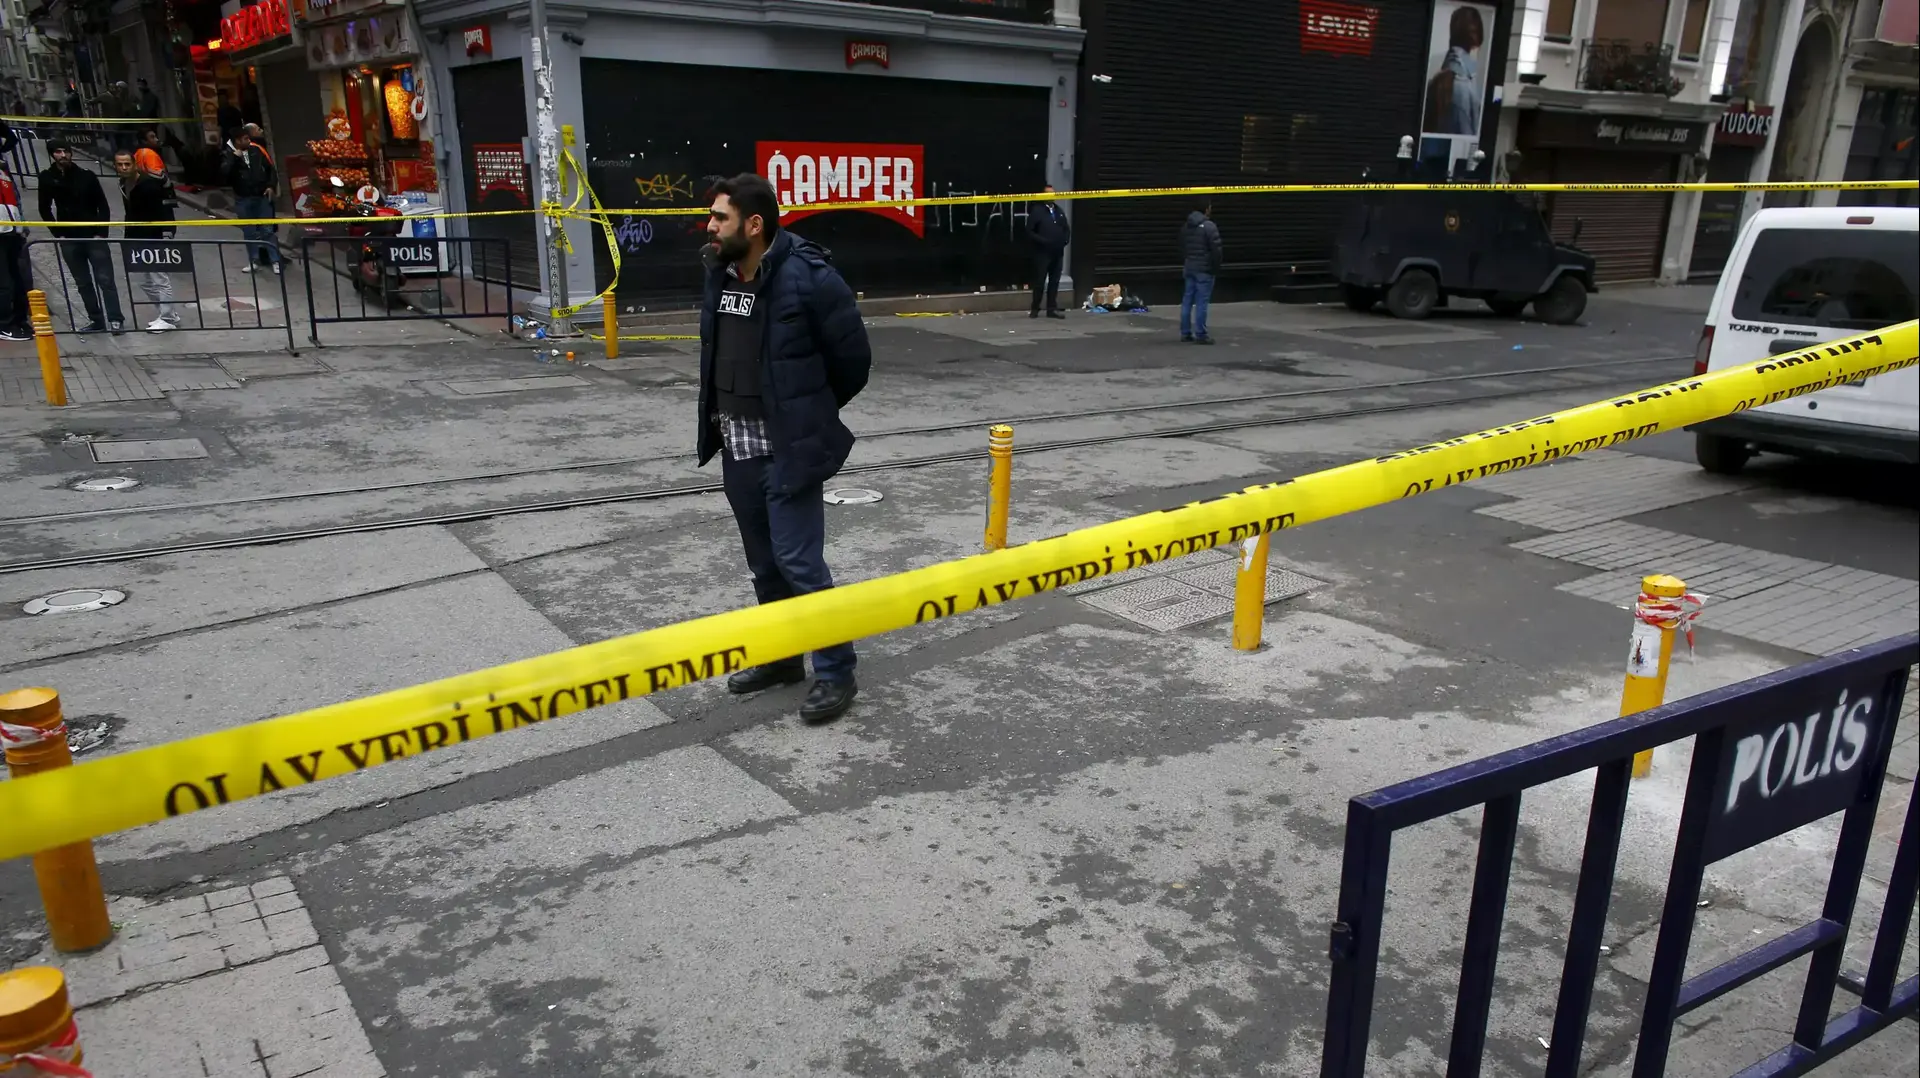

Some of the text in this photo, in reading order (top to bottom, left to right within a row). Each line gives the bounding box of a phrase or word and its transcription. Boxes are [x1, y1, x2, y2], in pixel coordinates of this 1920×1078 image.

[464, 29, 484, 48] CAMPER
[851, 43, 887, 62] CAMPER
[1722, 112, 1772, 135] TUDORS
[767, 154, 914, 218] CAMPER
[1728, 323, 1779, 334] TOURNEO
[1725, 688, 1872, 814] POLİS
